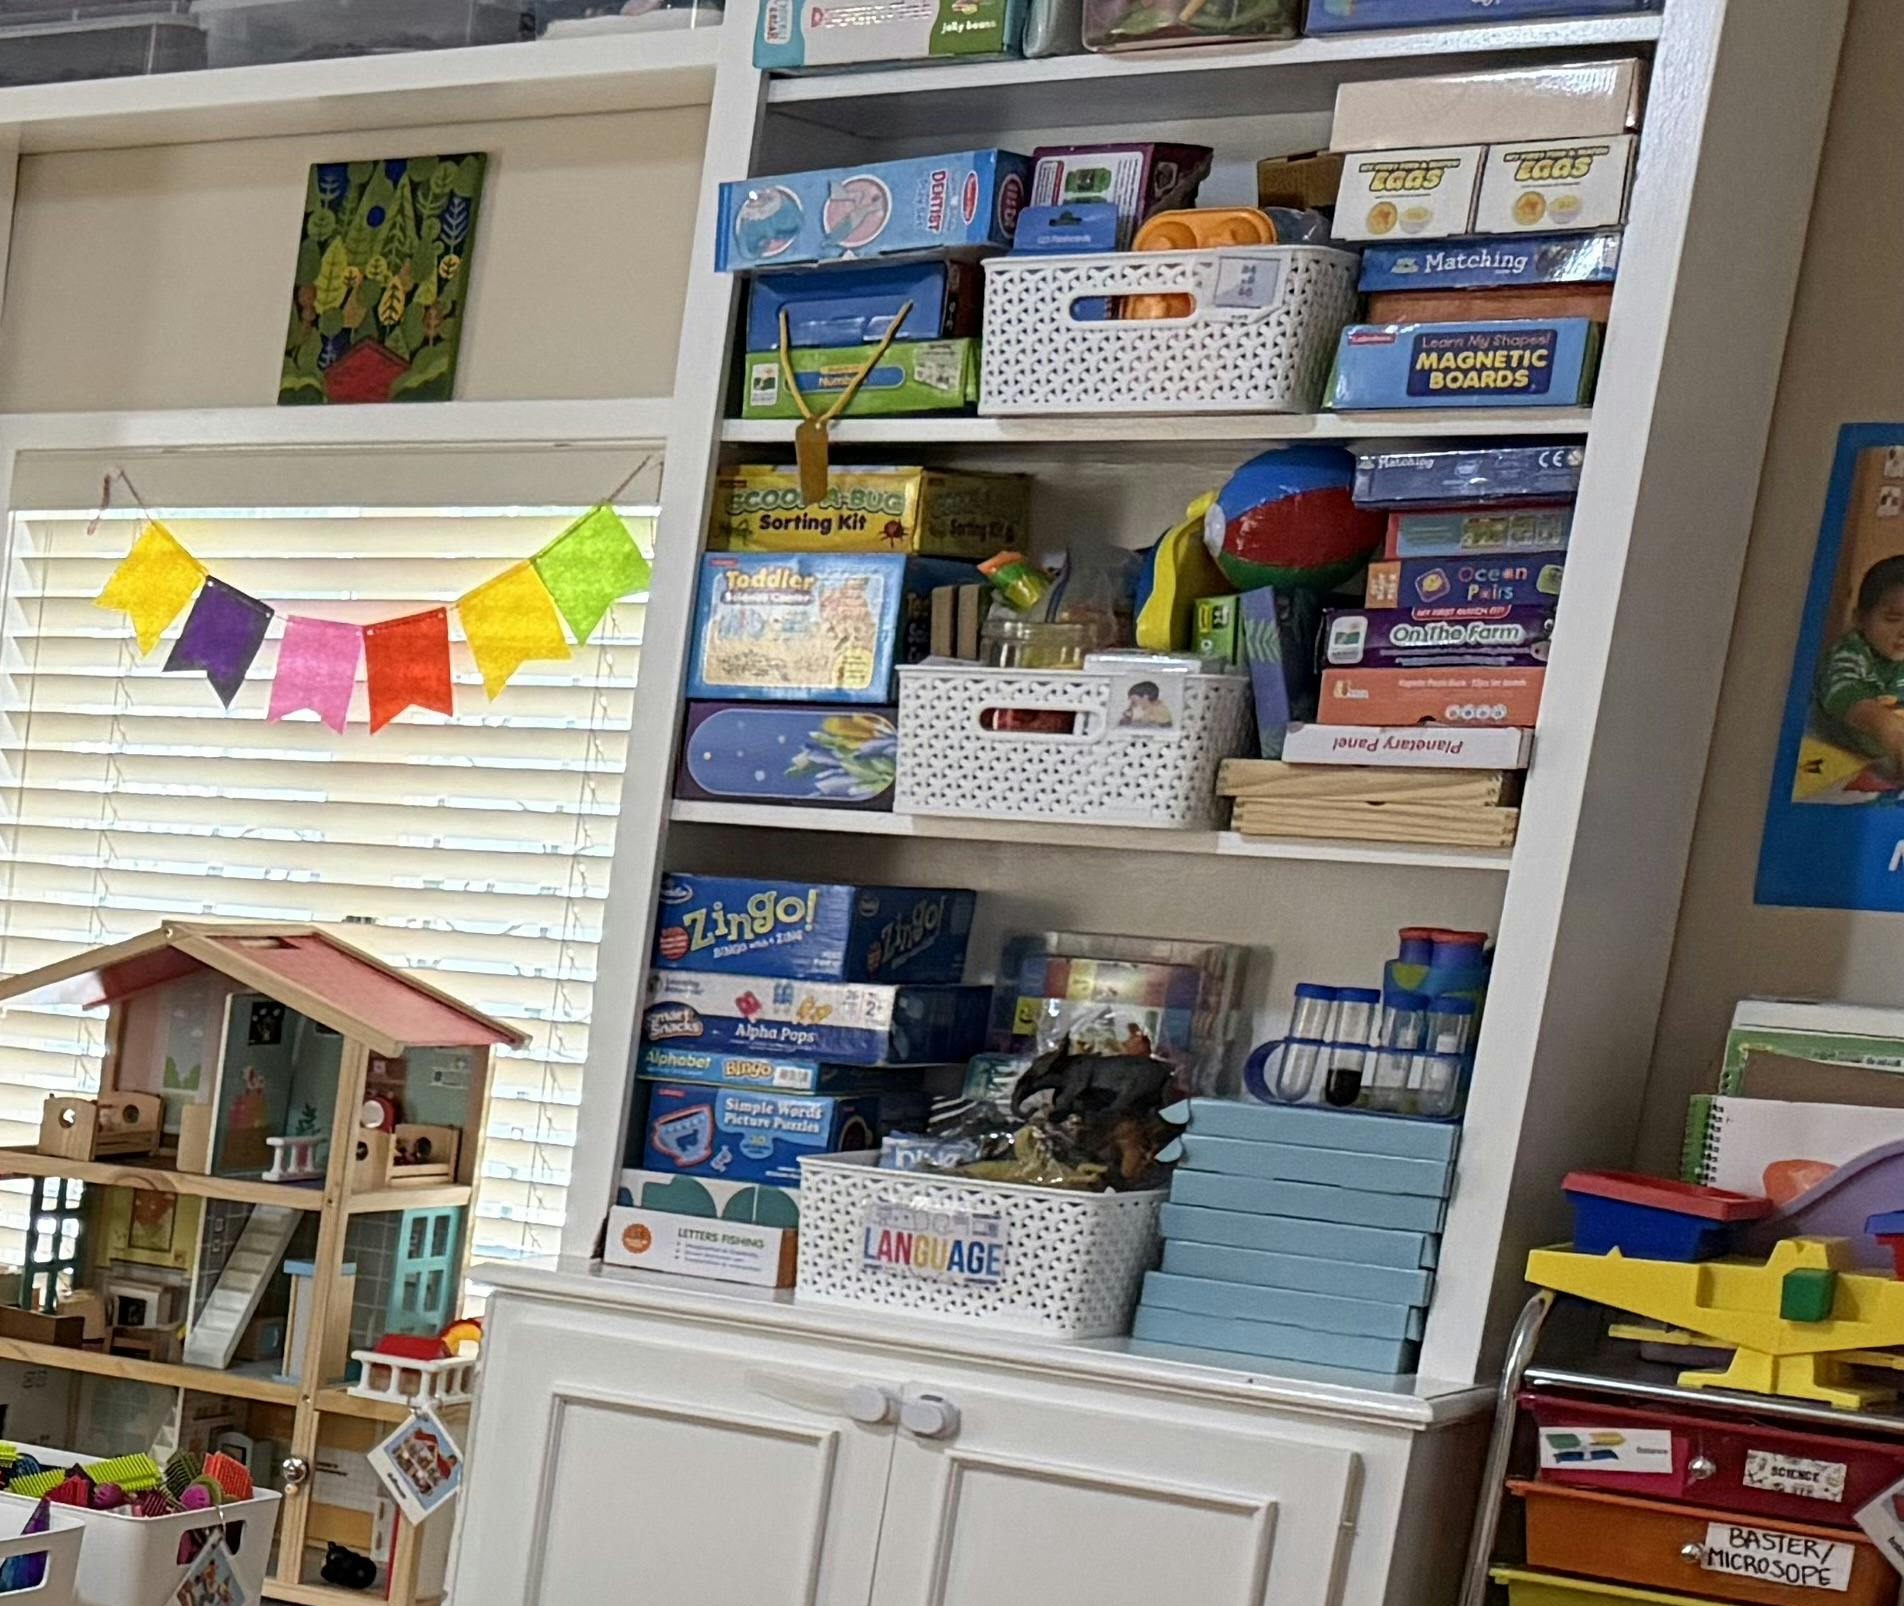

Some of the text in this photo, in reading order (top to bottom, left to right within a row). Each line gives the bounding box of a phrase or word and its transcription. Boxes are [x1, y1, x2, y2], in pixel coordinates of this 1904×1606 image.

[941, 20, 965, 34] jelly
[1515, 156, 1593, 181] EGGS
[1370, 169, 1444, 192] EGGS
[928, 169, 947, 232] DENTIST
[1424, 251, 1528, 275] Matching
[1422, 331, 1551, 349] Learn My Shapes!
[1415, 350, 1549, 370] MAGNETIC
[1429, 370, 1529, 390] BOARDS
[1538, 450, 1565, 467] CE
[759, 512, 867, 536] Sorting Kit
[726, 567, 817, 590] Toddler
[1458, 566, 1528, 583] Ocean
[1468, 583, 1514, 601] Pairs
[1392, 623, 1521, 643] On The Farm
[1333, 736, 1463, 754] Planetary Panel
[683, 888, 818, 951] Zingo!
[735, 1023, 815, 1043] Alpha Pops
[645, 1051, 773, 1078] Alphabet Bingo
[725, 1098, 823, 1119] Simple Words
[724, 1112, 821, 1134] Picture Puzzles
[678, 1227, 765, 1250] LETTERS FISHING
[863, 1226, 1004, 1277] LANGUAGE
[1770, 1465, 1820, 1484] SCIENCE
[1729, 1527, 1835, 1564] BASTER/
[1707, 1549, 1832, 1586] MICROSOPE
